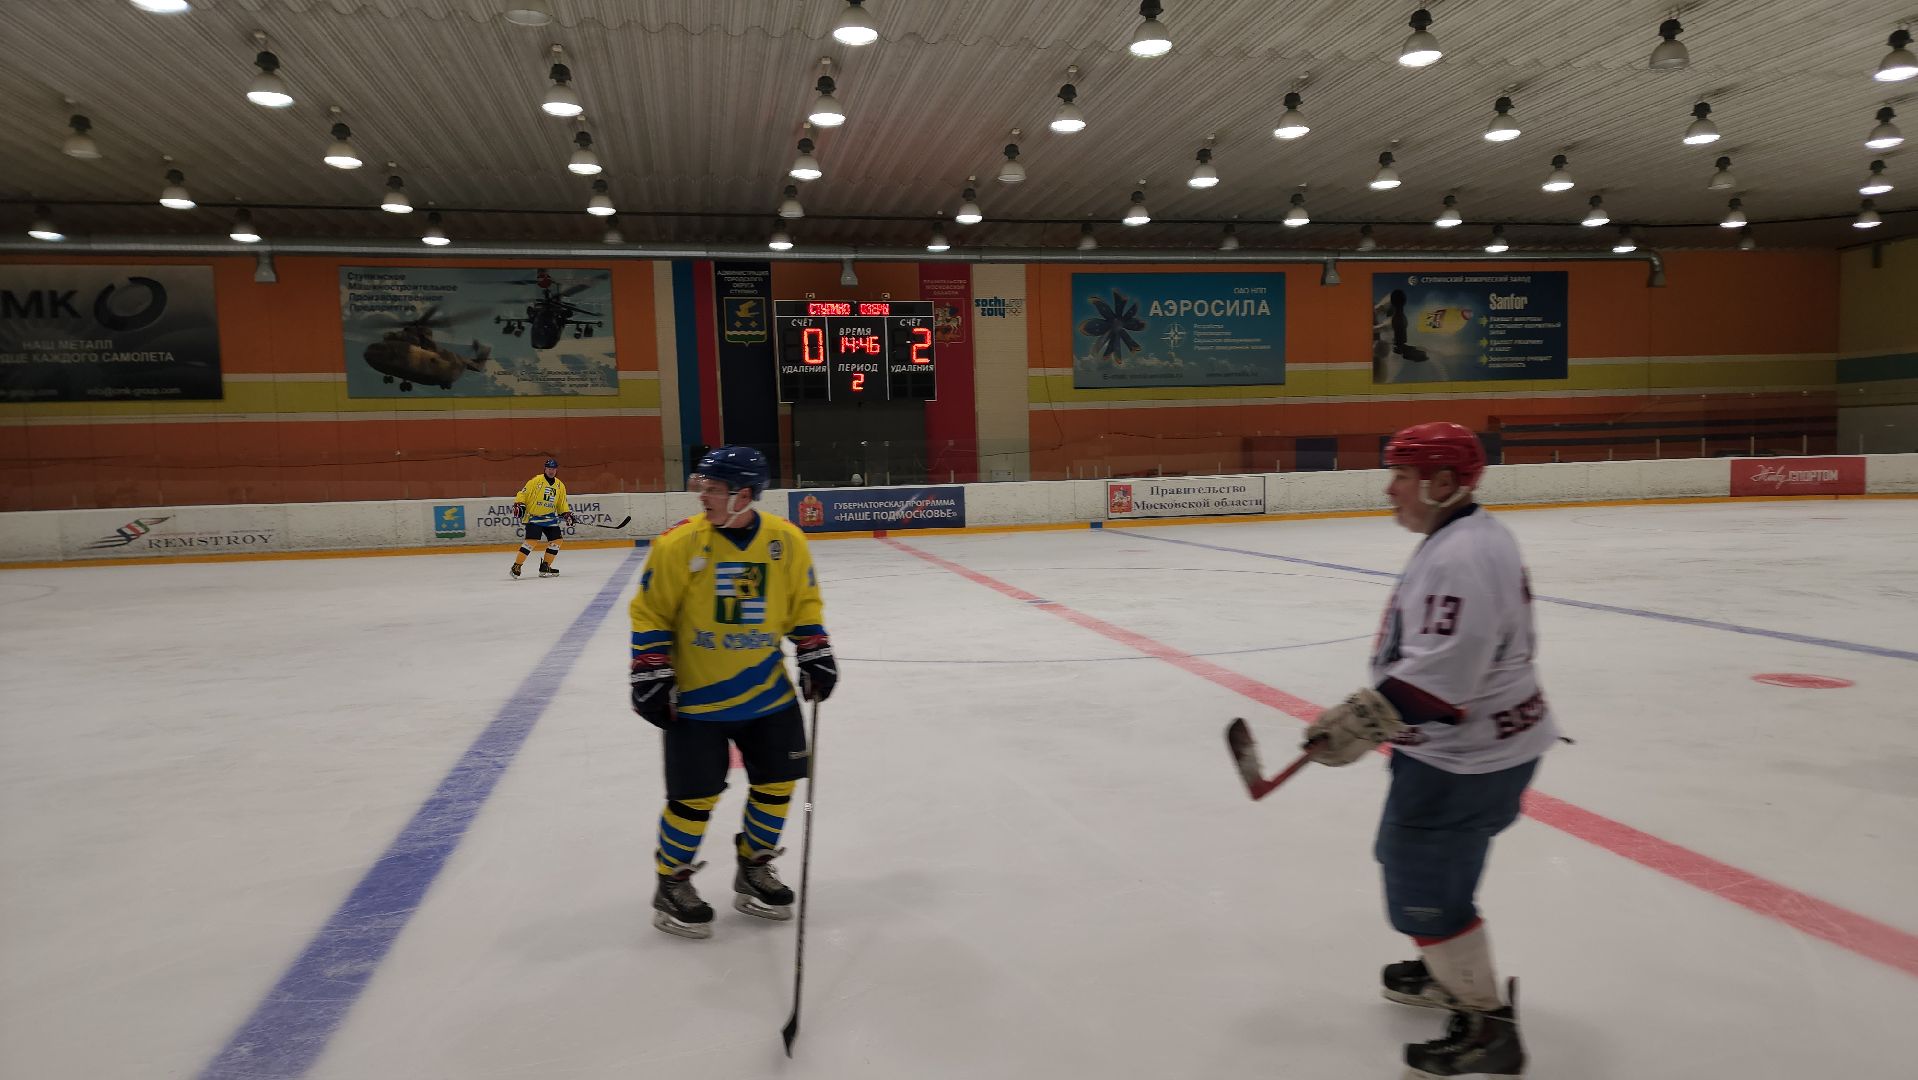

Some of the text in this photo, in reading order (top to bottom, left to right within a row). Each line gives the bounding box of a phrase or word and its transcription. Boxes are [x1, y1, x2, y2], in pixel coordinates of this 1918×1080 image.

[1233, 287, 1249, 295] ОАО
[1149, 298, 1271, 318] АЭРОСИЛА
[1488, 292, 1528, 311] Sanfor
[839, 327, 872, 337] ВРЕМЯ
[23, 338, 112, 350] НАШ МЕТАЛЛ
[803, 327, 826, 365] 0
[840, 336, 881, 355] 14:46
[911, 327, 933, 364] 2
[32, 352, 98, 363] КАЖДОГО
[102, 351, 175, 362] САМОЛЕТА
[781, 365, 828, 375] УДАЛЕНИЯ
[837, 363, 879, 374] ПЕРИОД
[891, 364, 935, 374] УДАЛЕНИЯ
[851, 373, 866, 391] 2
[1149, 484, 1247, 498] Правительство
[833, 499, 957, 511] ГУБЕРНАТОРСКАЯ ПРОГРАММА
[1133, 496, 1263, 511] Московской области
[575, 513, 612, 526] КРУГА
[148, 534, 273, 550] REMSTROY
[1420, 594, 1463, 636] 13
